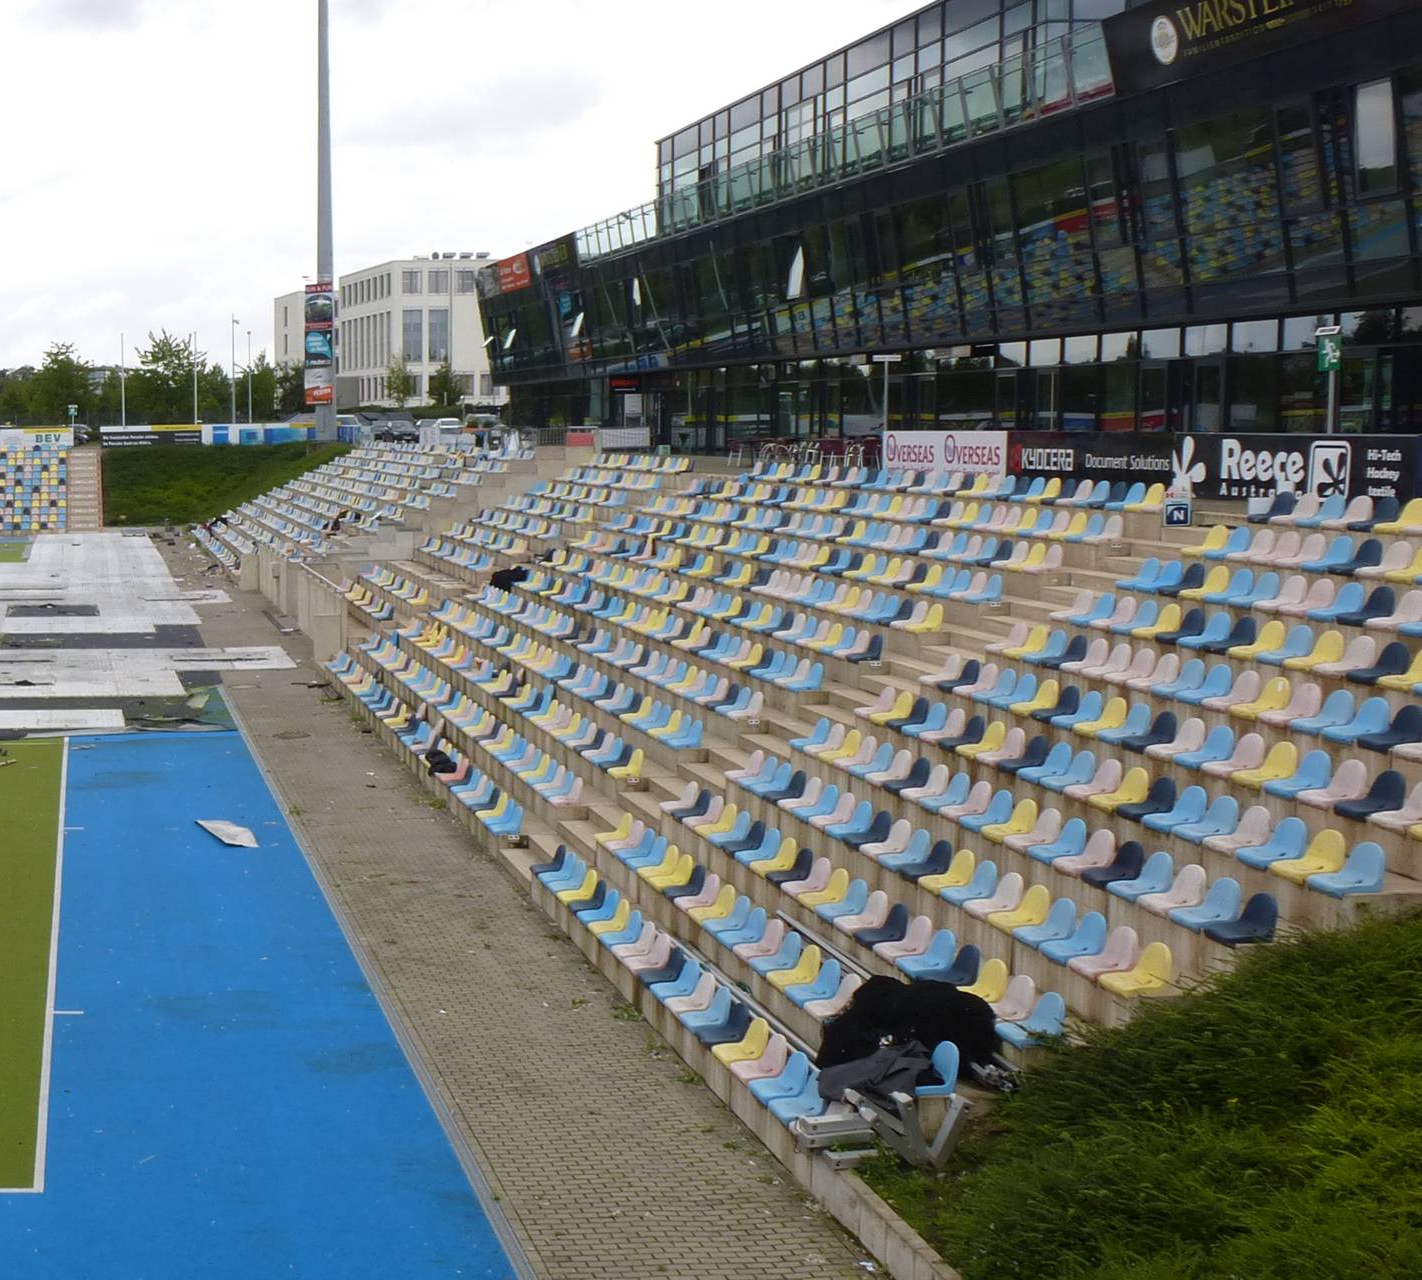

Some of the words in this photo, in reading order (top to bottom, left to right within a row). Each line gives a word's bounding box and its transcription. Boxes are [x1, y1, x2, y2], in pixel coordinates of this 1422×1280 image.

[1175, 0, 1295, 41] WARST
[35, 433, 61, 443] BEV
[886, 434, 935, 463] OVERSEAS
[944, 434, 1000, 466] OVERSEAS
[1367, 449, 1402, 461] Hi-Tech
[1085, 453, 1128, 470] Document
[1129, 454, 1170, 471] Solutions
[1220, 438, 1305, 483] Reece
[1366, 467, 1400, 482] Hockey
[1219, 482, 1303, 499] Austraa
